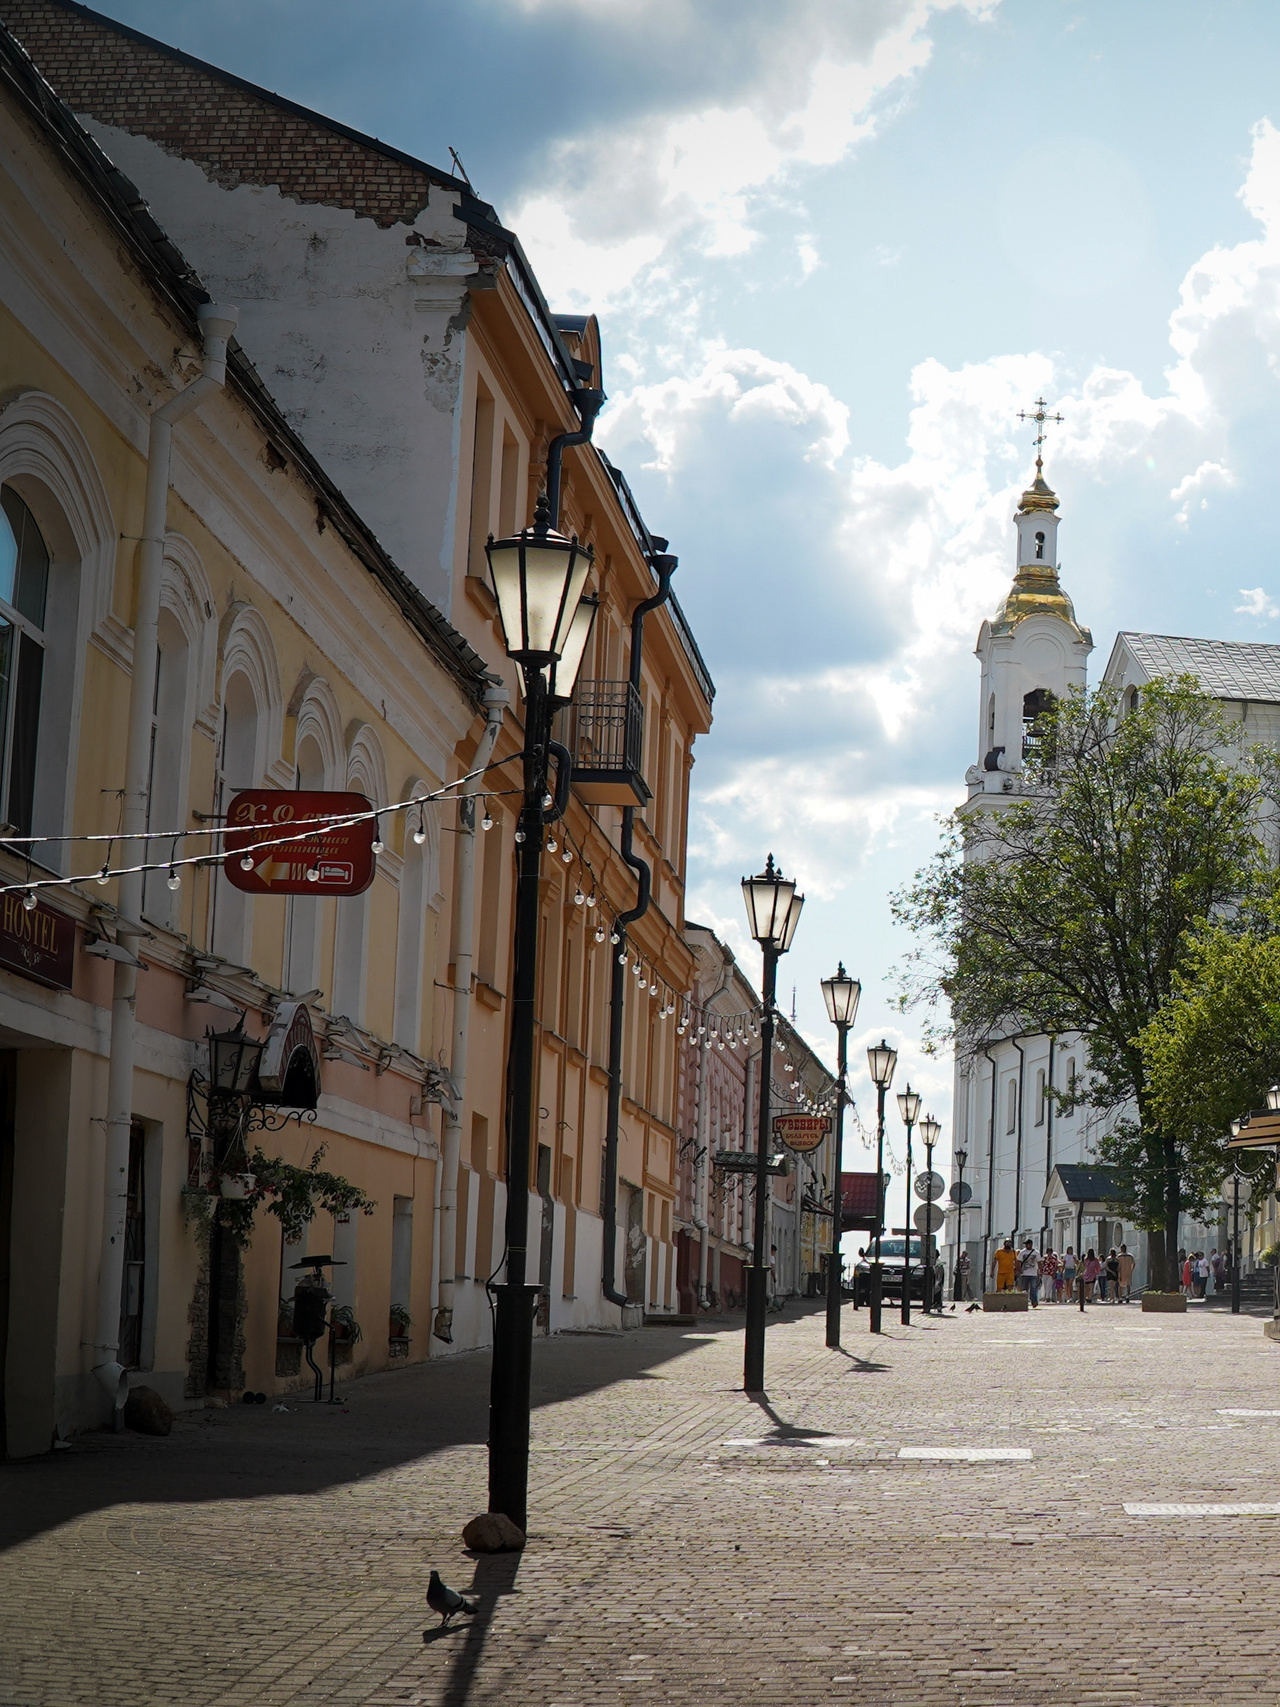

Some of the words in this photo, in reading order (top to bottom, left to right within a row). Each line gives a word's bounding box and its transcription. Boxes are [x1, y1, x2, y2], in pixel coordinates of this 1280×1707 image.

[255, 844, 339, 857] остиница
[2, 894, 59, 955] HOSTEL
[775, 1118, 829, 1131] СУВЕНИРЫ
